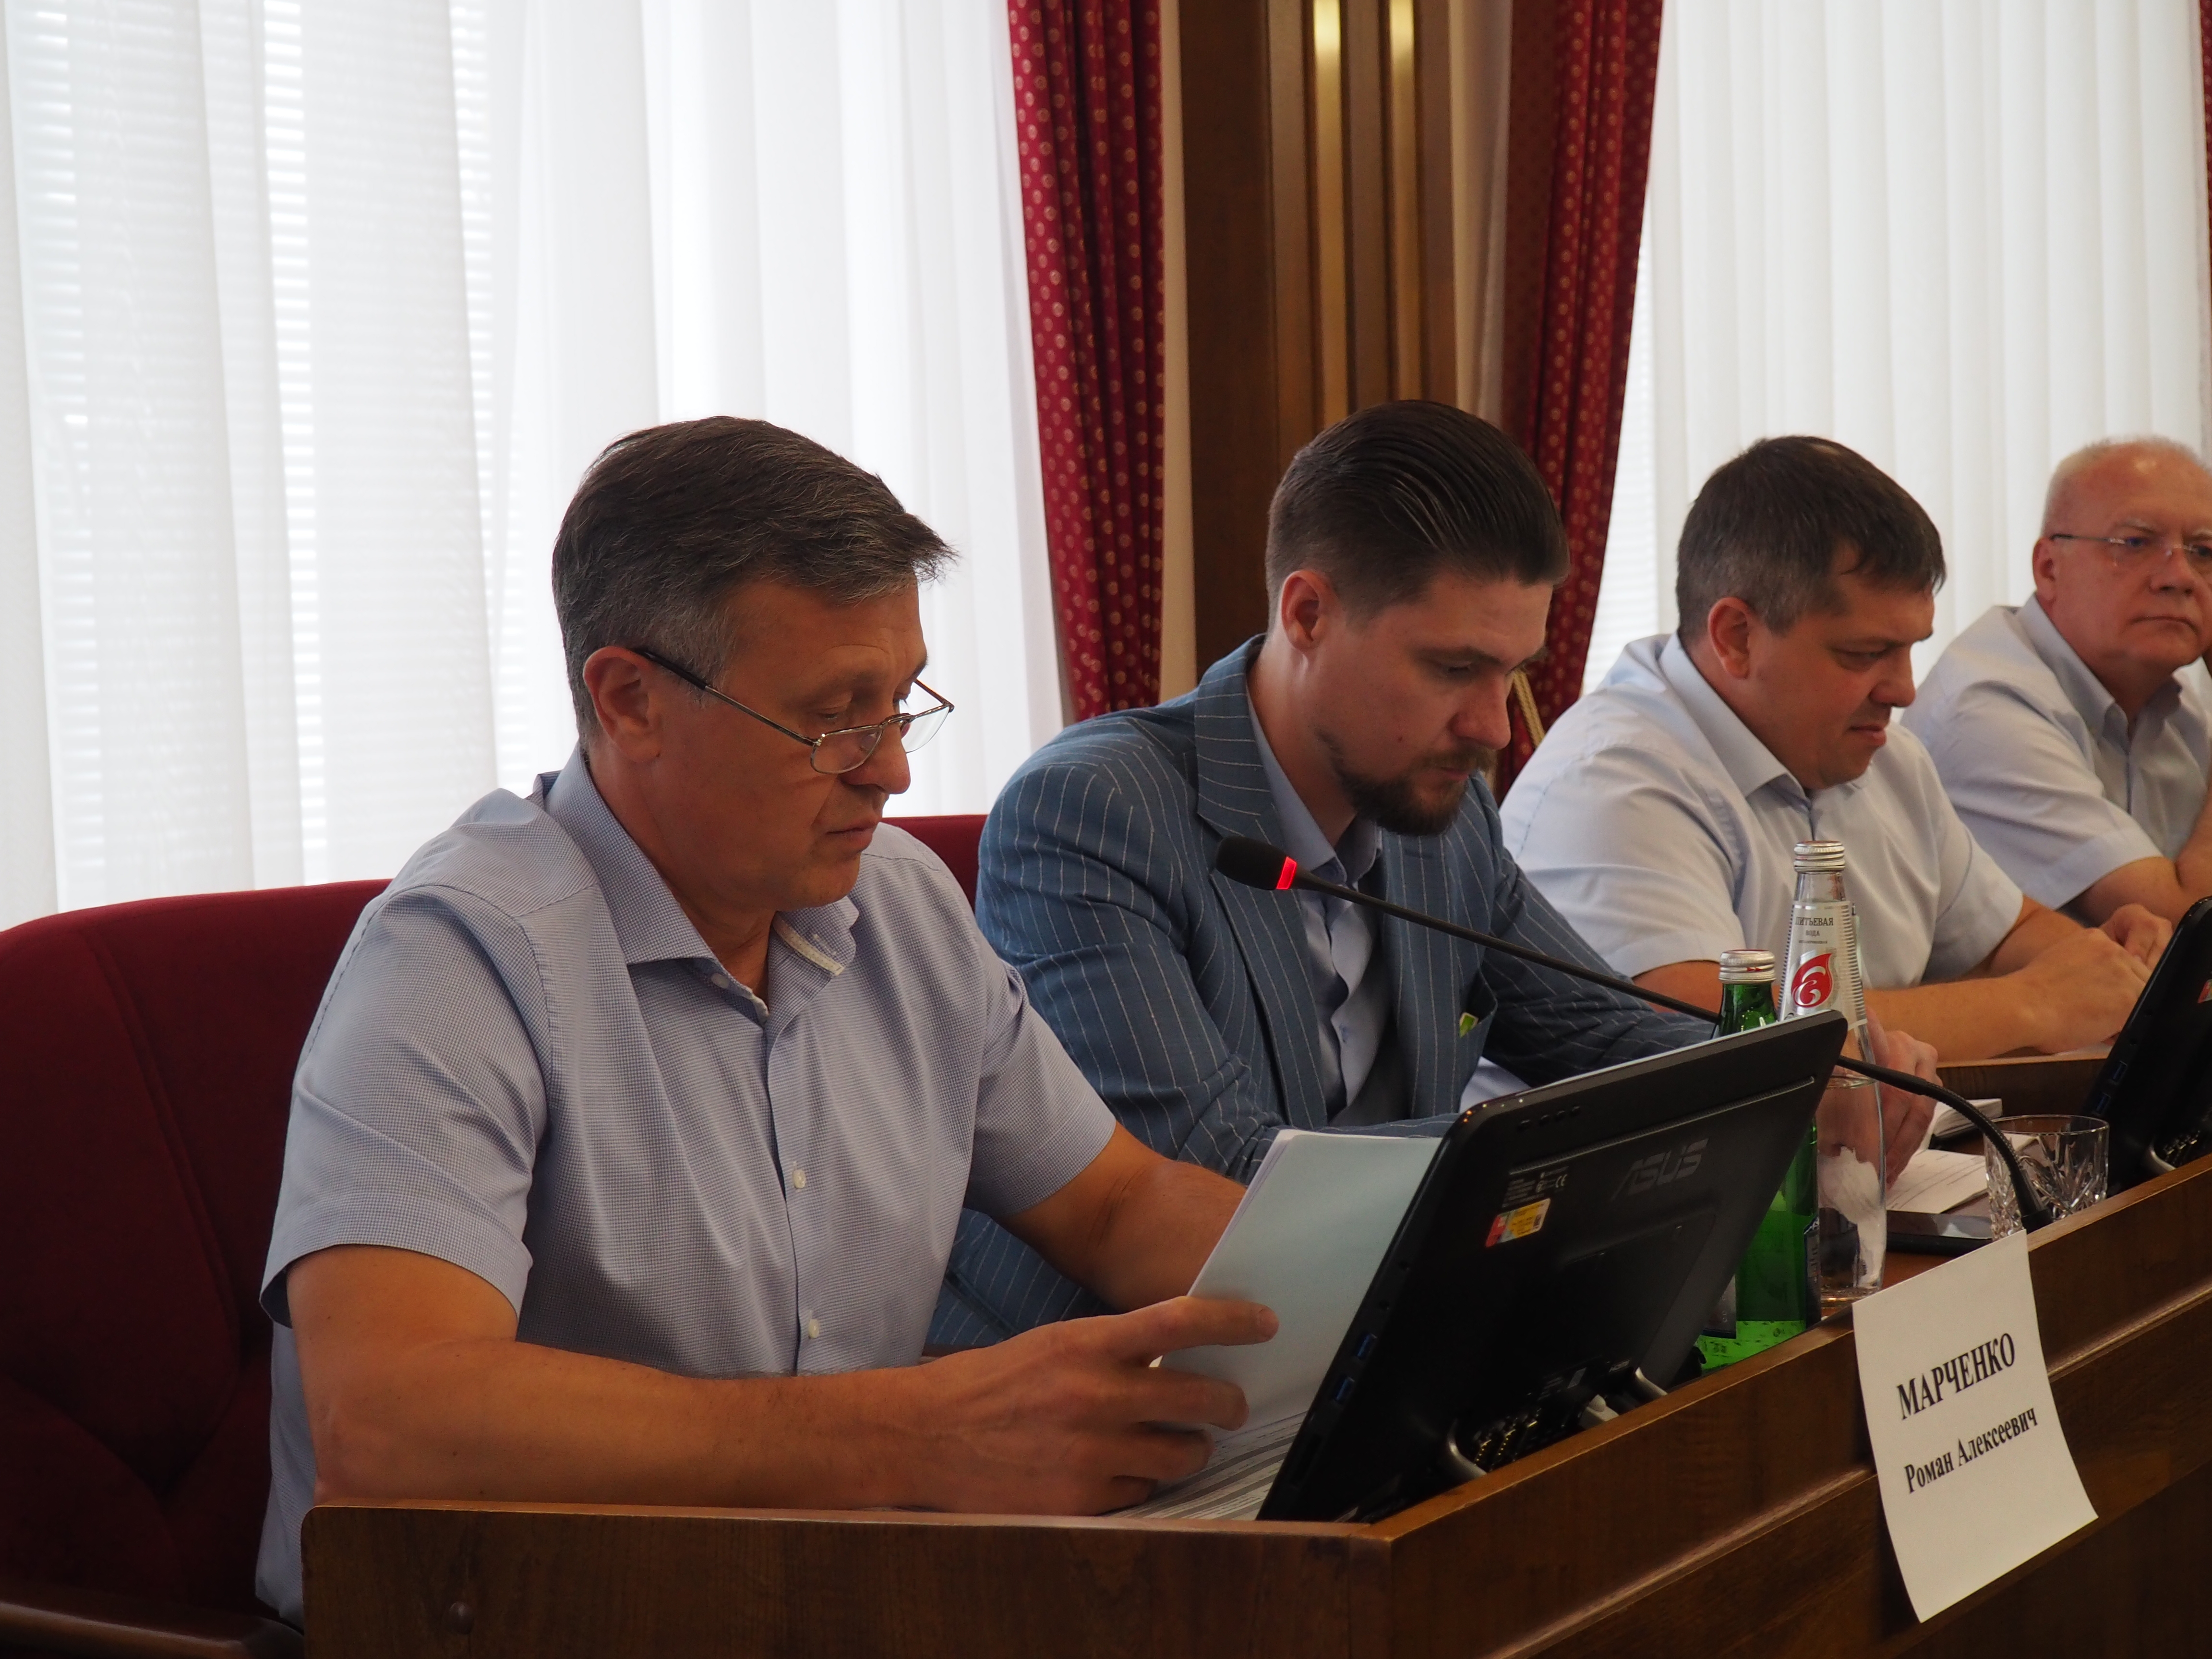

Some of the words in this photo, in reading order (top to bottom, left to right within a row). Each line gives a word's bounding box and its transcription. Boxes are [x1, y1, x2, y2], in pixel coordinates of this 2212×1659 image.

[1795, 916, 1833, 926] ПИТЬЕВАЯ
[1611, 1138, 1709, 1202] ASUS
[1896, 1333, 2016, 1420] МАРЧЕНКО
[1904, 1451, 1955, 1494] Роман
[1957, 1407, 2039, 1467] Алексеевич
